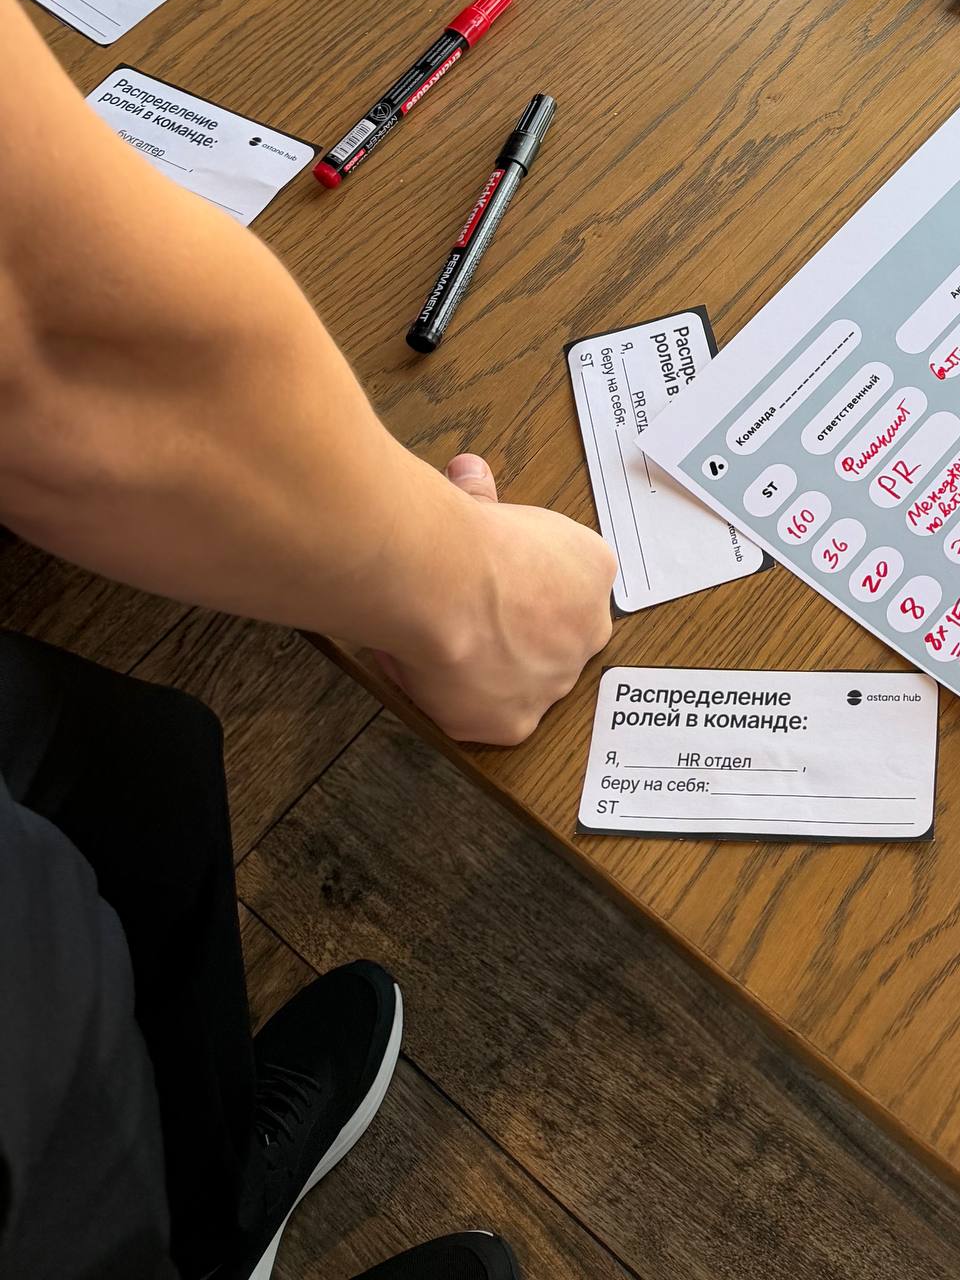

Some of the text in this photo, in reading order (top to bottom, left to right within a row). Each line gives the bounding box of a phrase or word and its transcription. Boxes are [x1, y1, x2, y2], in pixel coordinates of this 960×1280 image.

[97, 92, 218, 148] ролей в команде:
[113, 79, 218, 130] Распределение
[261, 142, 298, 162] astana hub
[420, 254, 460, 322] PERMANENT
[580, 353, 594, 368] ST
[620, 342, 634, 355] Я,
[632, 391, 646, 409] PR
[649, 332, 681, 396] ролей в
[600, 348, 627, 427] беру на себя:
[817, 374, 881, 441] ответственный
[735, 405, 777, 447] Команда
[762, 481, 778, 498] ST
[877, 460, 921, 499] PR
[786, 509, 815, 539] 160
[727, 521, 743, 562] tana hub
[823, 538, 848, 569] 36
[861, 561, 888, 593] 20
[900, 596, 925, 619] 8
[615, 684, 792, 708] Распределение
[867, 693, 922, 703] astana hub
[611, 709, 808, 733] ролей в команде:
[605, 751, 752, 770] Я, HR отдел
[600, 776, 710, 793] беру на себя:
[596, 800, 619, 815] ST
